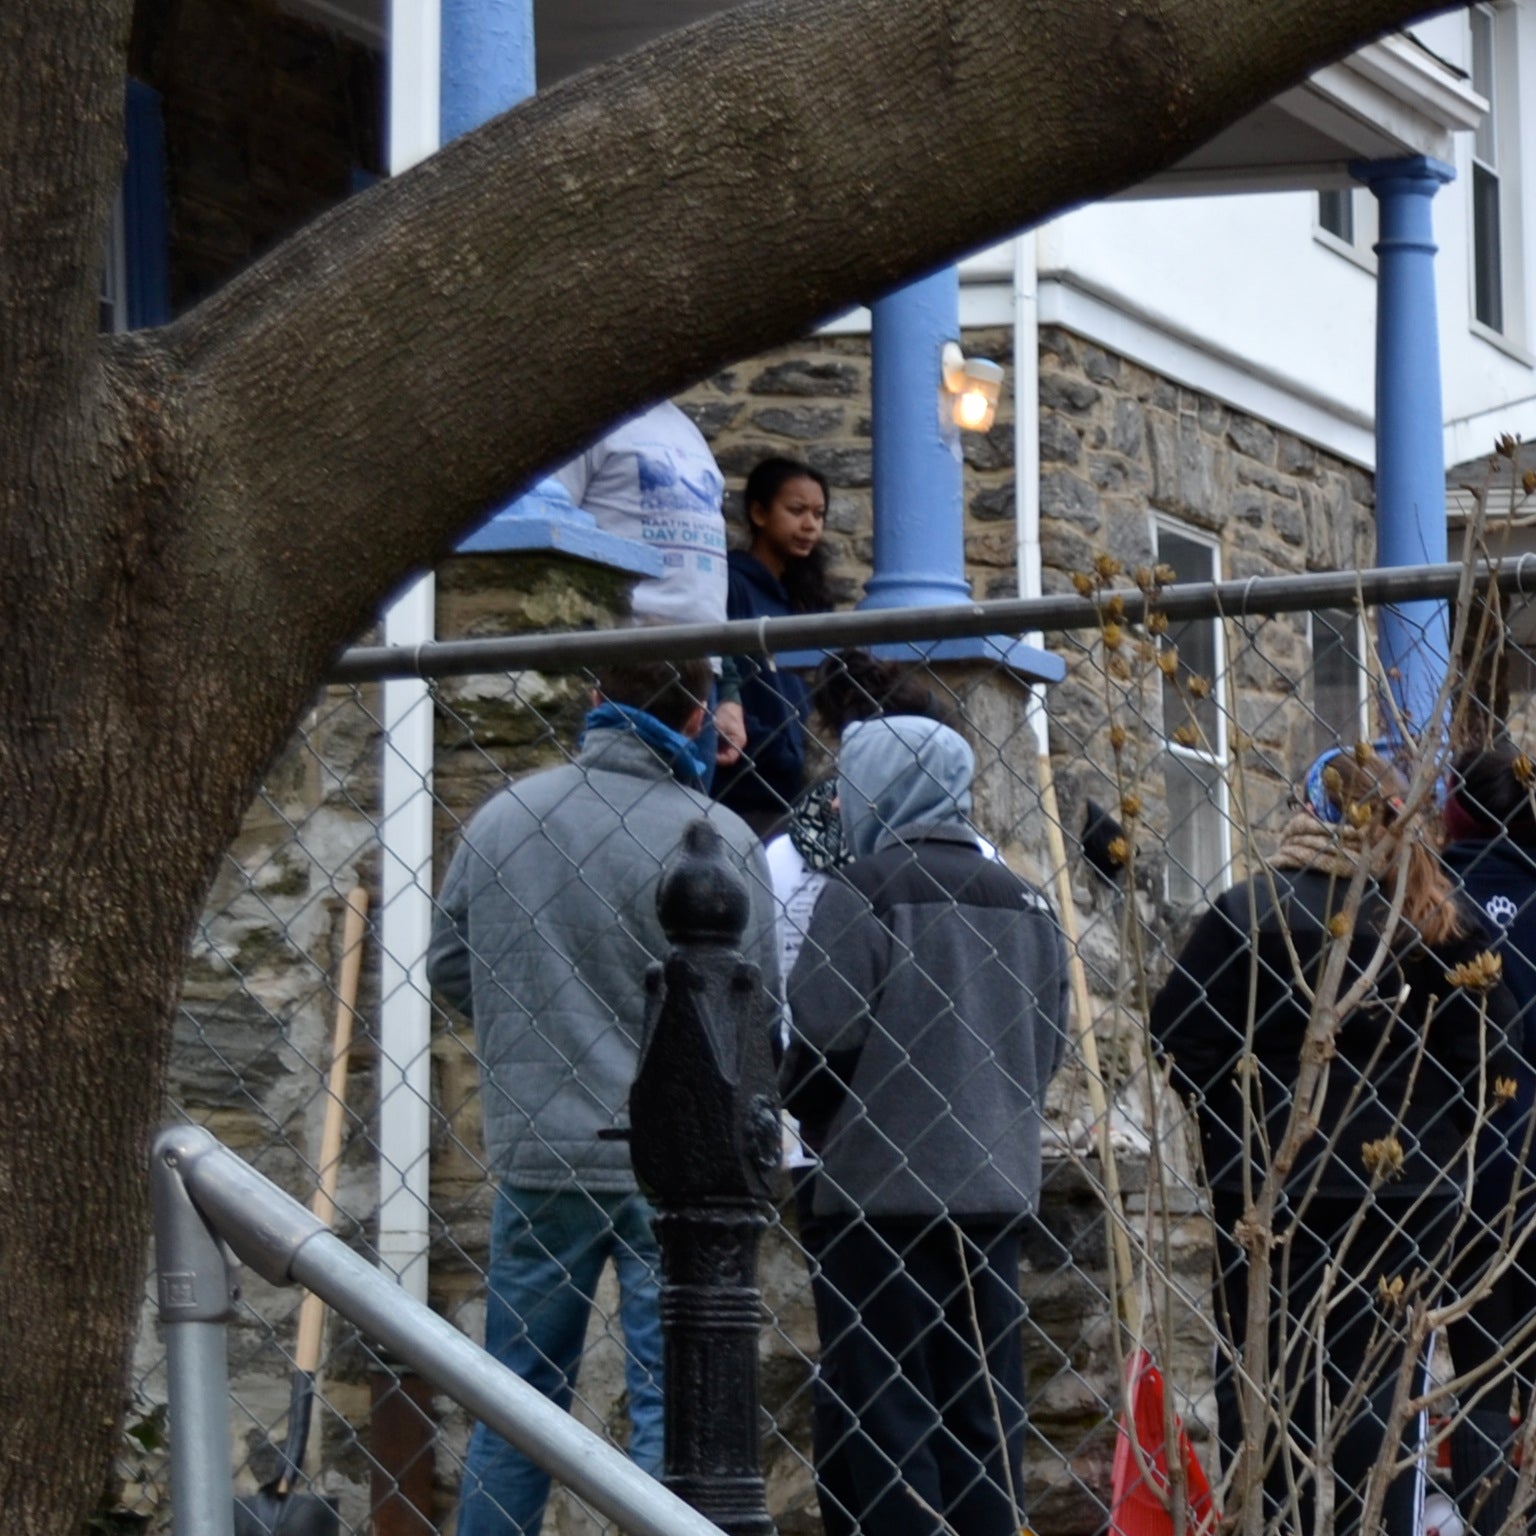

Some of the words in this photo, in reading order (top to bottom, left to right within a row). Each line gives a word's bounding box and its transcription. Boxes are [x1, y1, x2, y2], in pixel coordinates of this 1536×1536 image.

[641, 519, 690, 527] MARTIN
[642, 528, 676, 540] DAY
[681, 528, 699, 541] OF
